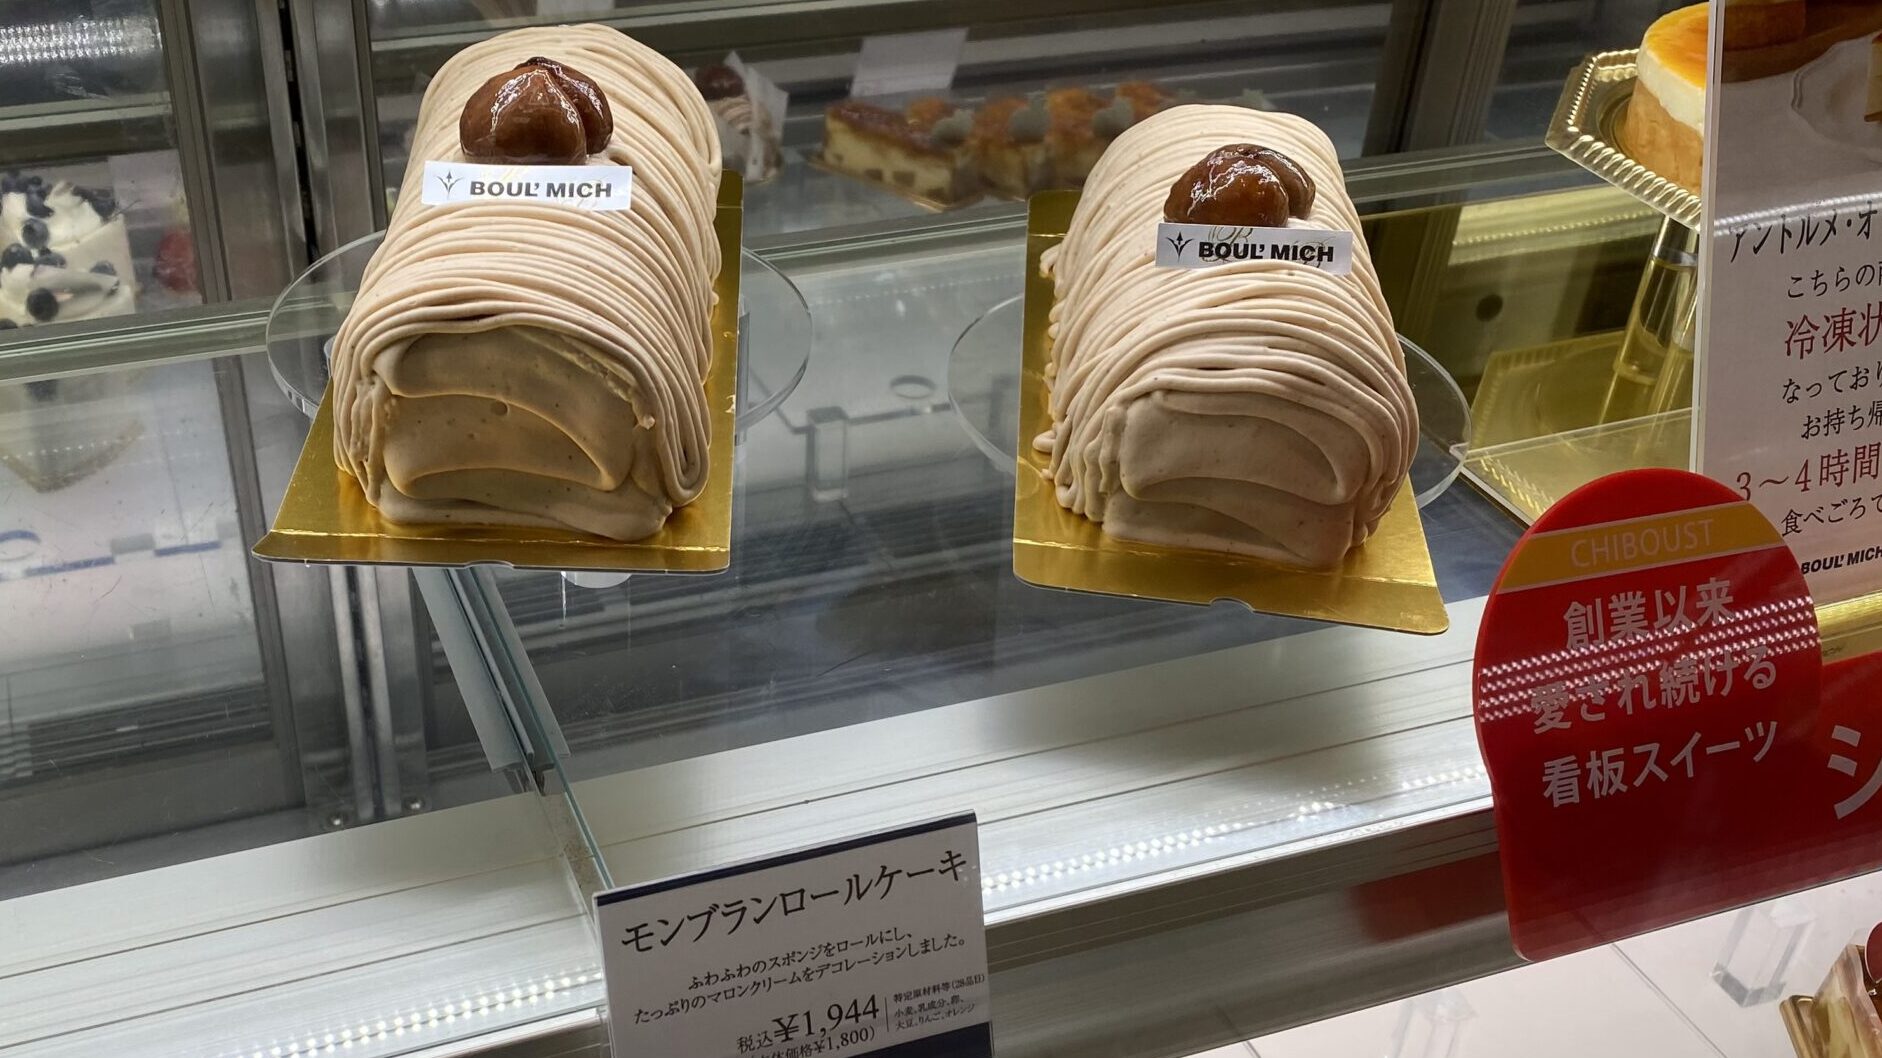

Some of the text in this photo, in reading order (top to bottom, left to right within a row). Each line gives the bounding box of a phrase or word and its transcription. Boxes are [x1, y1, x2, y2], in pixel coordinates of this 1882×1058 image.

[469, 180, 612, 198] BOUL' MICH
[1198, 241, 1334, 262] BOUL' MICH
[1787, 261, 1882, 298] こちらの
[1570, 519, 1714, 568] CHIBOUST
[1562, 576, 1734, 650] 創業以来
[1529, 644, 1777, 735] 愛され続ける
[1542, 720, 1778, 808] 看板スイーツ
[620, 849, 967, 954] モンブランロールケーキ
[634, 932, 966, 1024] たっぷりのマロンクリームをデコレーションしました。
[688, 926, 914, 991] ふわふわのスポンジをロールにし、
